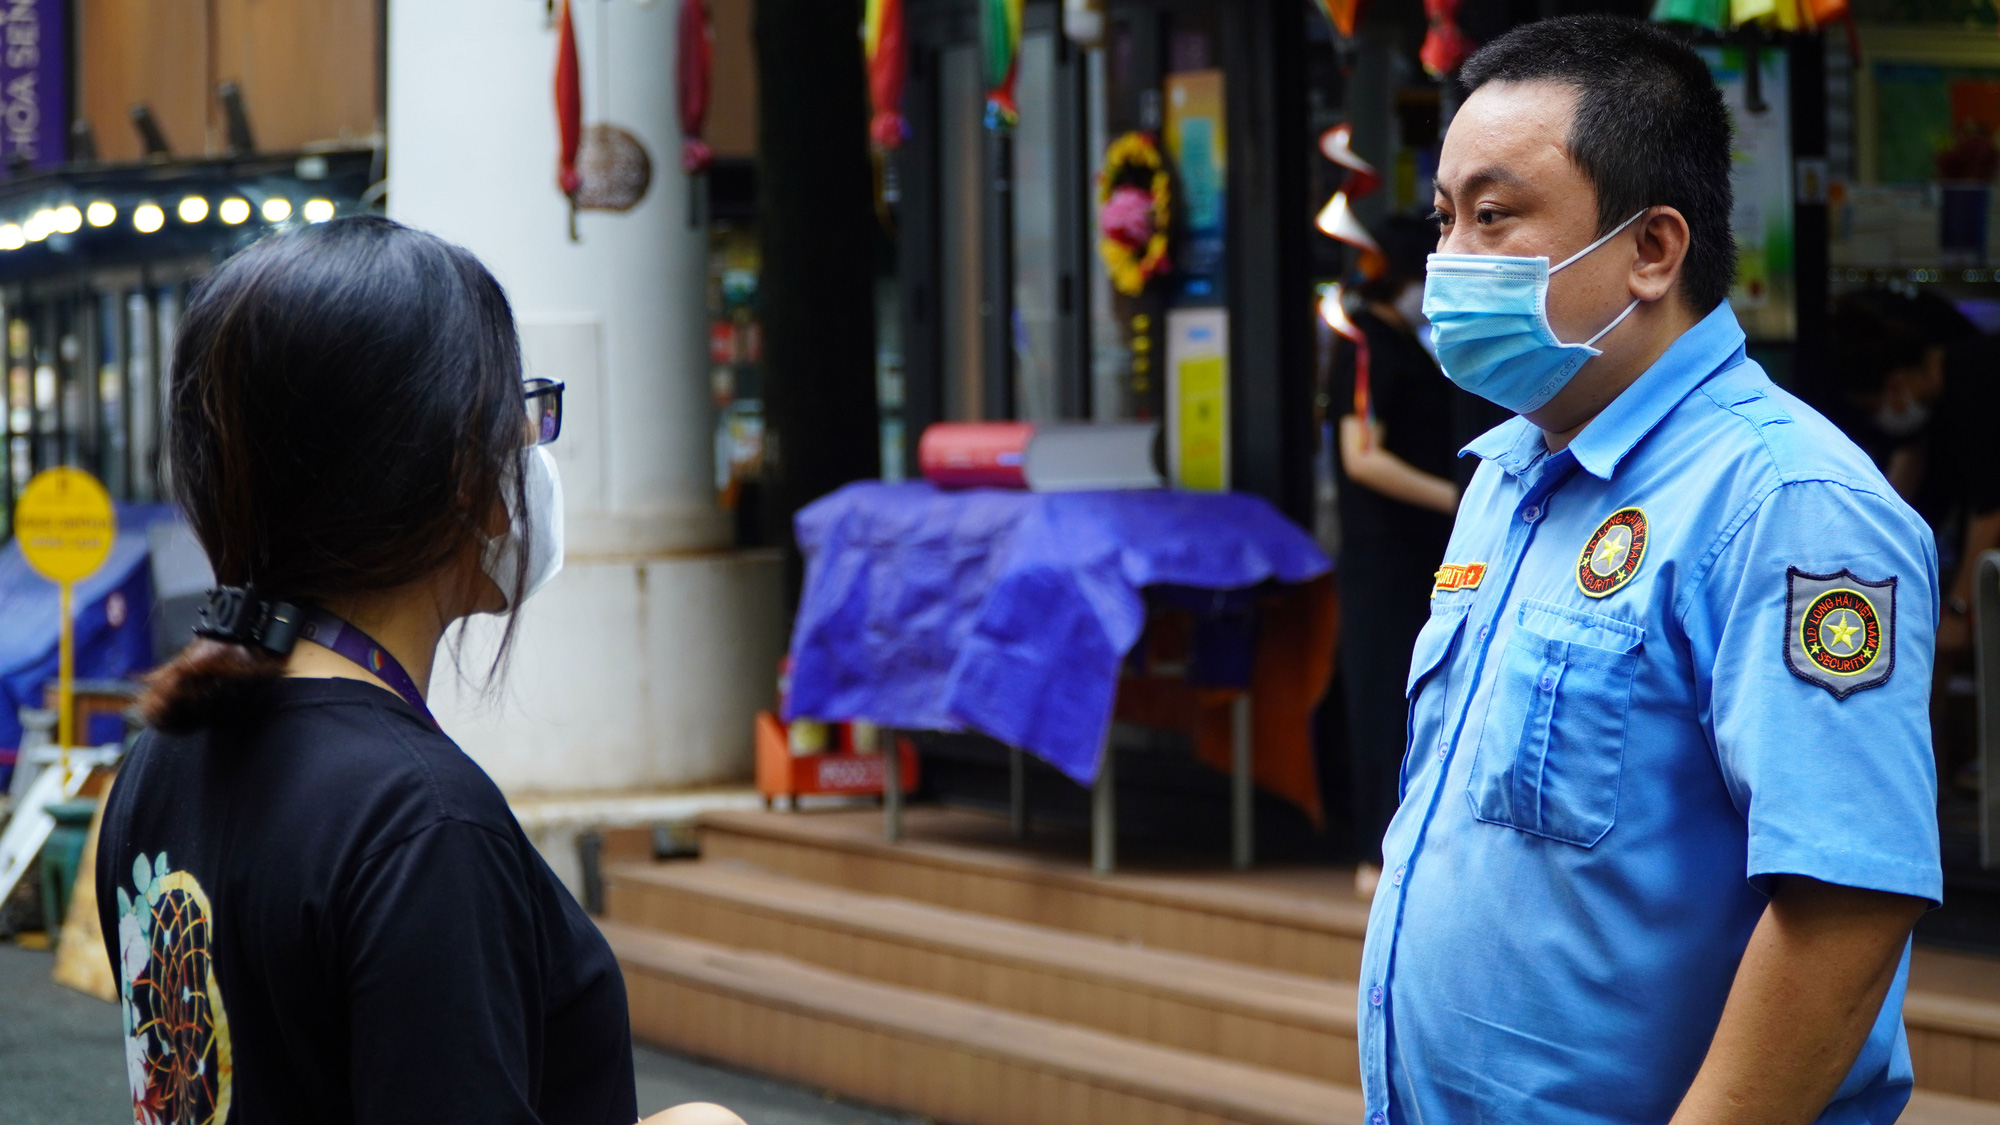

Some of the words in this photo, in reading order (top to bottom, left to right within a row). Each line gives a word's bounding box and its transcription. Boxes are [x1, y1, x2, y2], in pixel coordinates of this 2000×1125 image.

[5, 0, 41, 69] SEN
[1597, 513, 1624, 539] LONG
[1625, 542, 1643, 571] NAM
[1581, 565, 1616, 591] SECURITY
[1809, 598, 1834, 625] LONG
[1866, 620, 1878, 649] NAM
[1817, 652, 1866, 670] SECURITY
